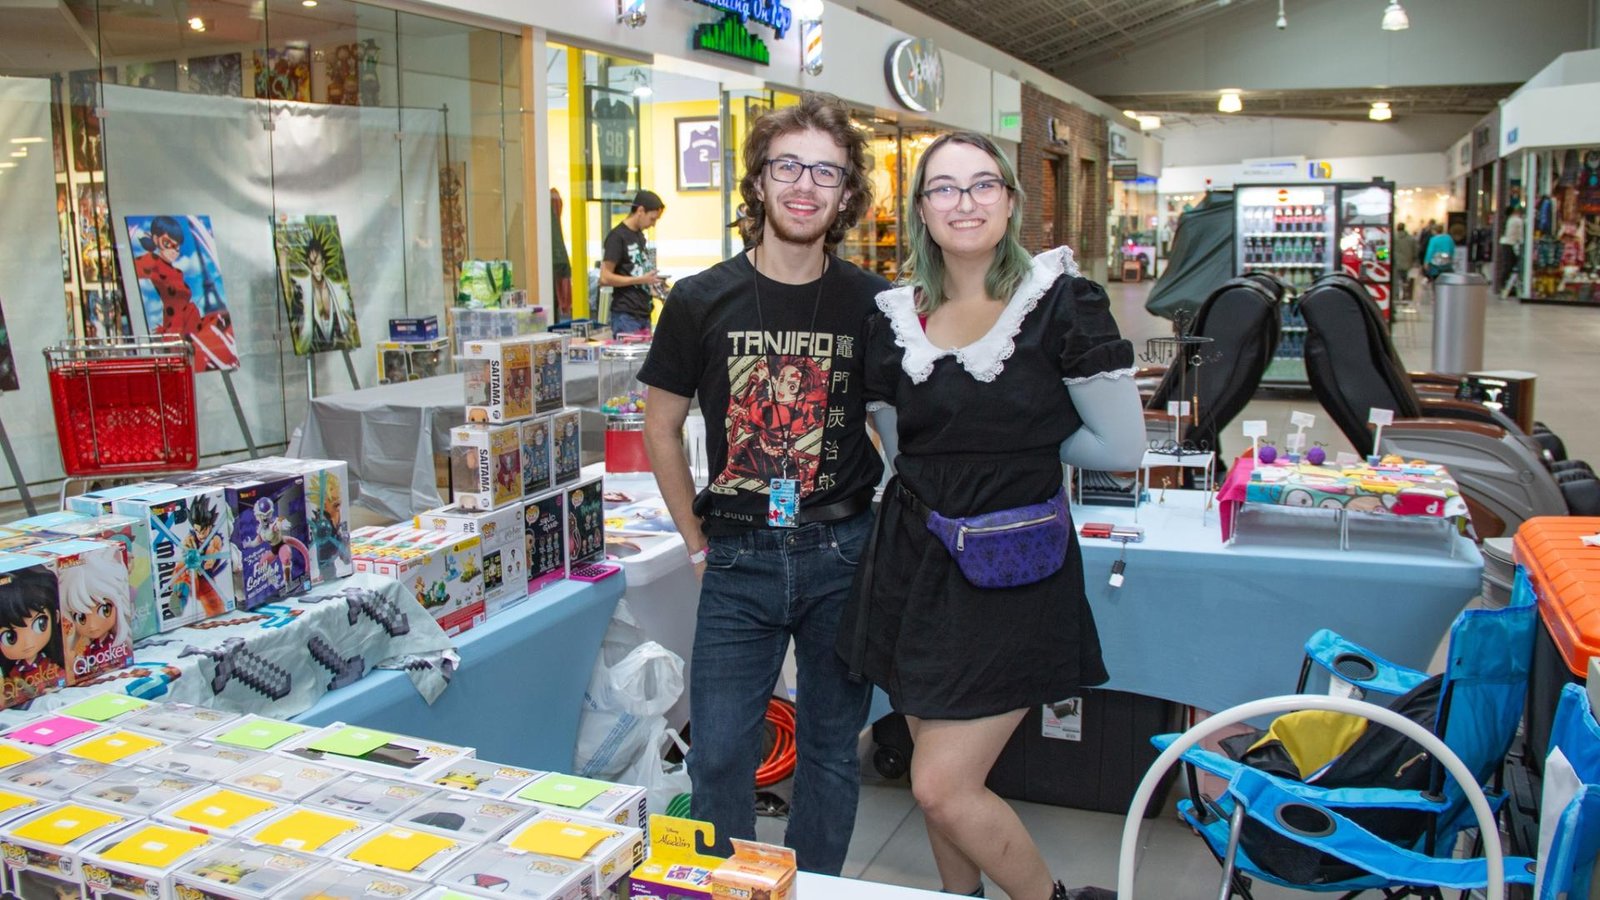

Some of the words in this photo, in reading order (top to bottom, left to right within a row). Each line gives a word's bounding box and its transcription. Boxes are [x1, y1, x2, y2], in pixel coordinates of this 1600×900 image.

[605, 130, 624, 158] 98
[699, 149, 709, 162] 2
[727, 331, 834, 356] TANJIRO
[491, 360, 501, 406] SAITAMA
[480, 449, 490, 493] SAITAMA
[73, 643, 129, 675] Qposket
